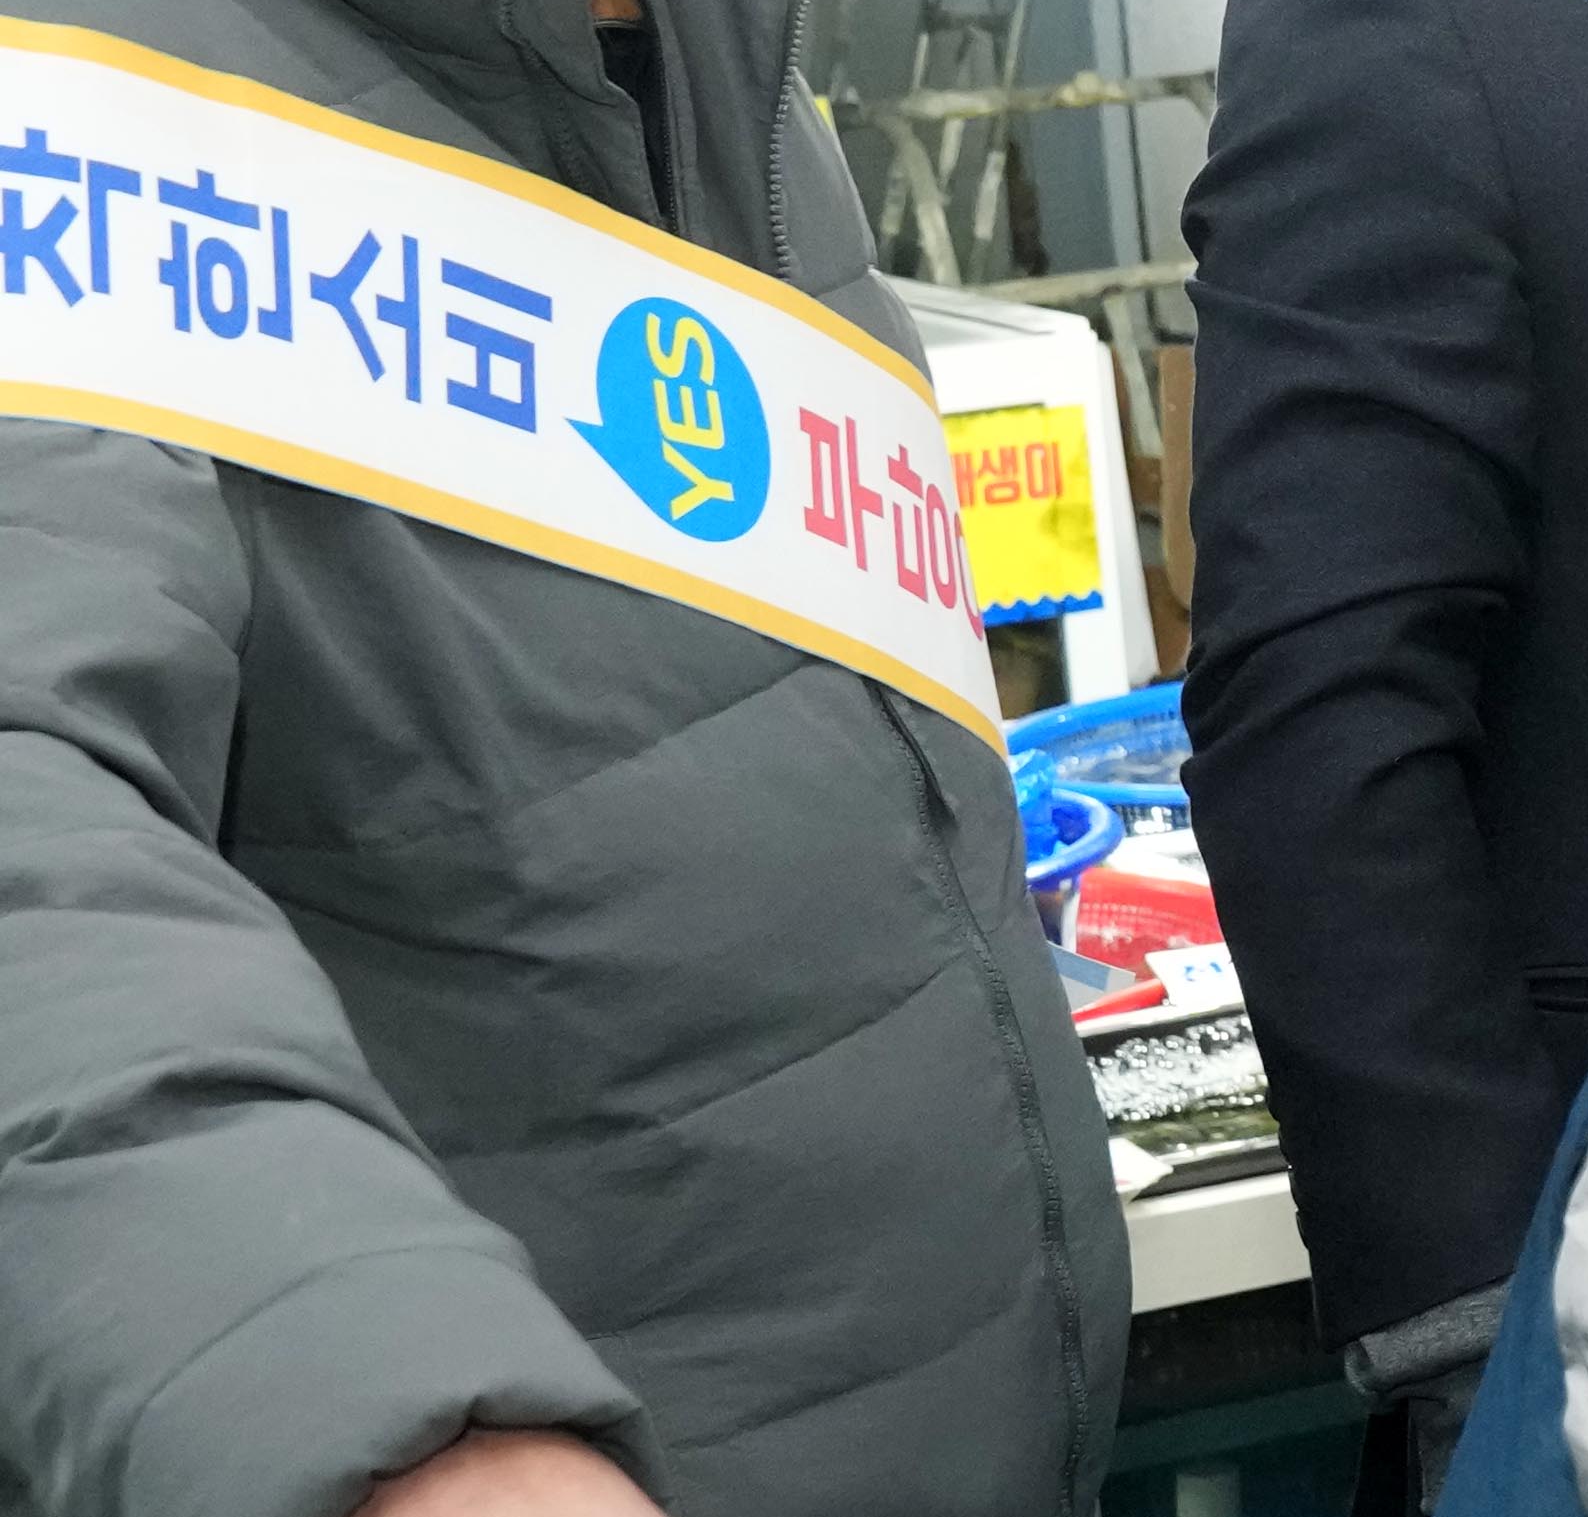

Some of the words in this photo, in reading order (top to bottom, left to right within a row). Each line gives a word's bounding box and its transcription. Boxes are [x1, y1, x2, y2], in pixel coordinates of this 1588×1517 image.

[0, 126, 552, 433] 착한소비
[645, 312, 738, 519] YES
[799, 405, 983, 642] 부당
